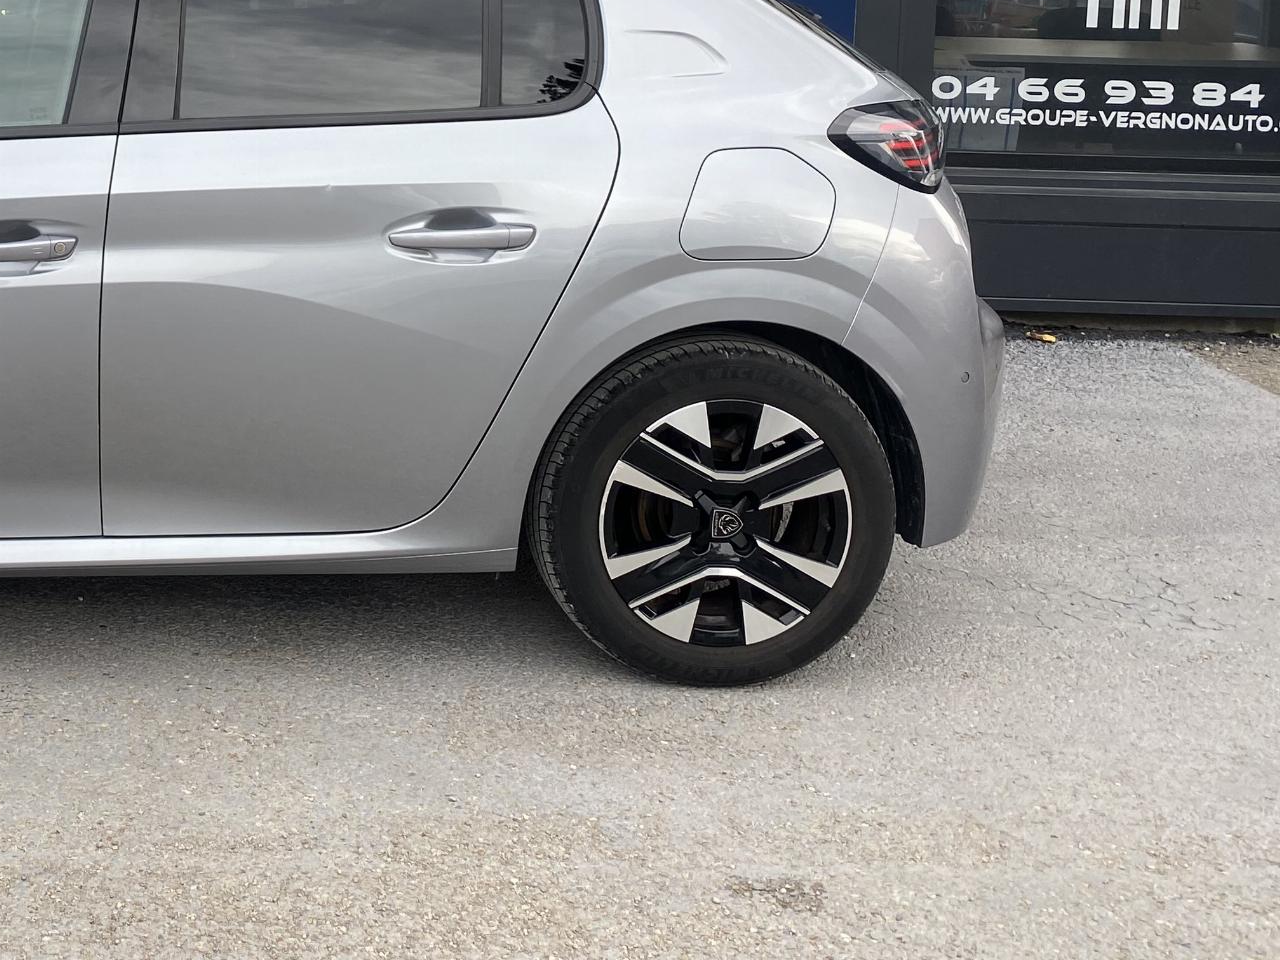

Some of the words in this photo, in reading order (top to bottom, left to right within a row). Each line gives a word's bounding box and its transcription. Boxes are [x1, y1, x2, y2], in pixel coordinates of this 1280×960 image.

[931, 75, 1001, 101] 04
[1017, 77, 1086, 103] 66
[1104, 79, 1175, 106] 93
[1192, 82, 1266, 108] 84
[932, 105, 1280, 133] WWW.GROUPE-VERGNONAUTO.
